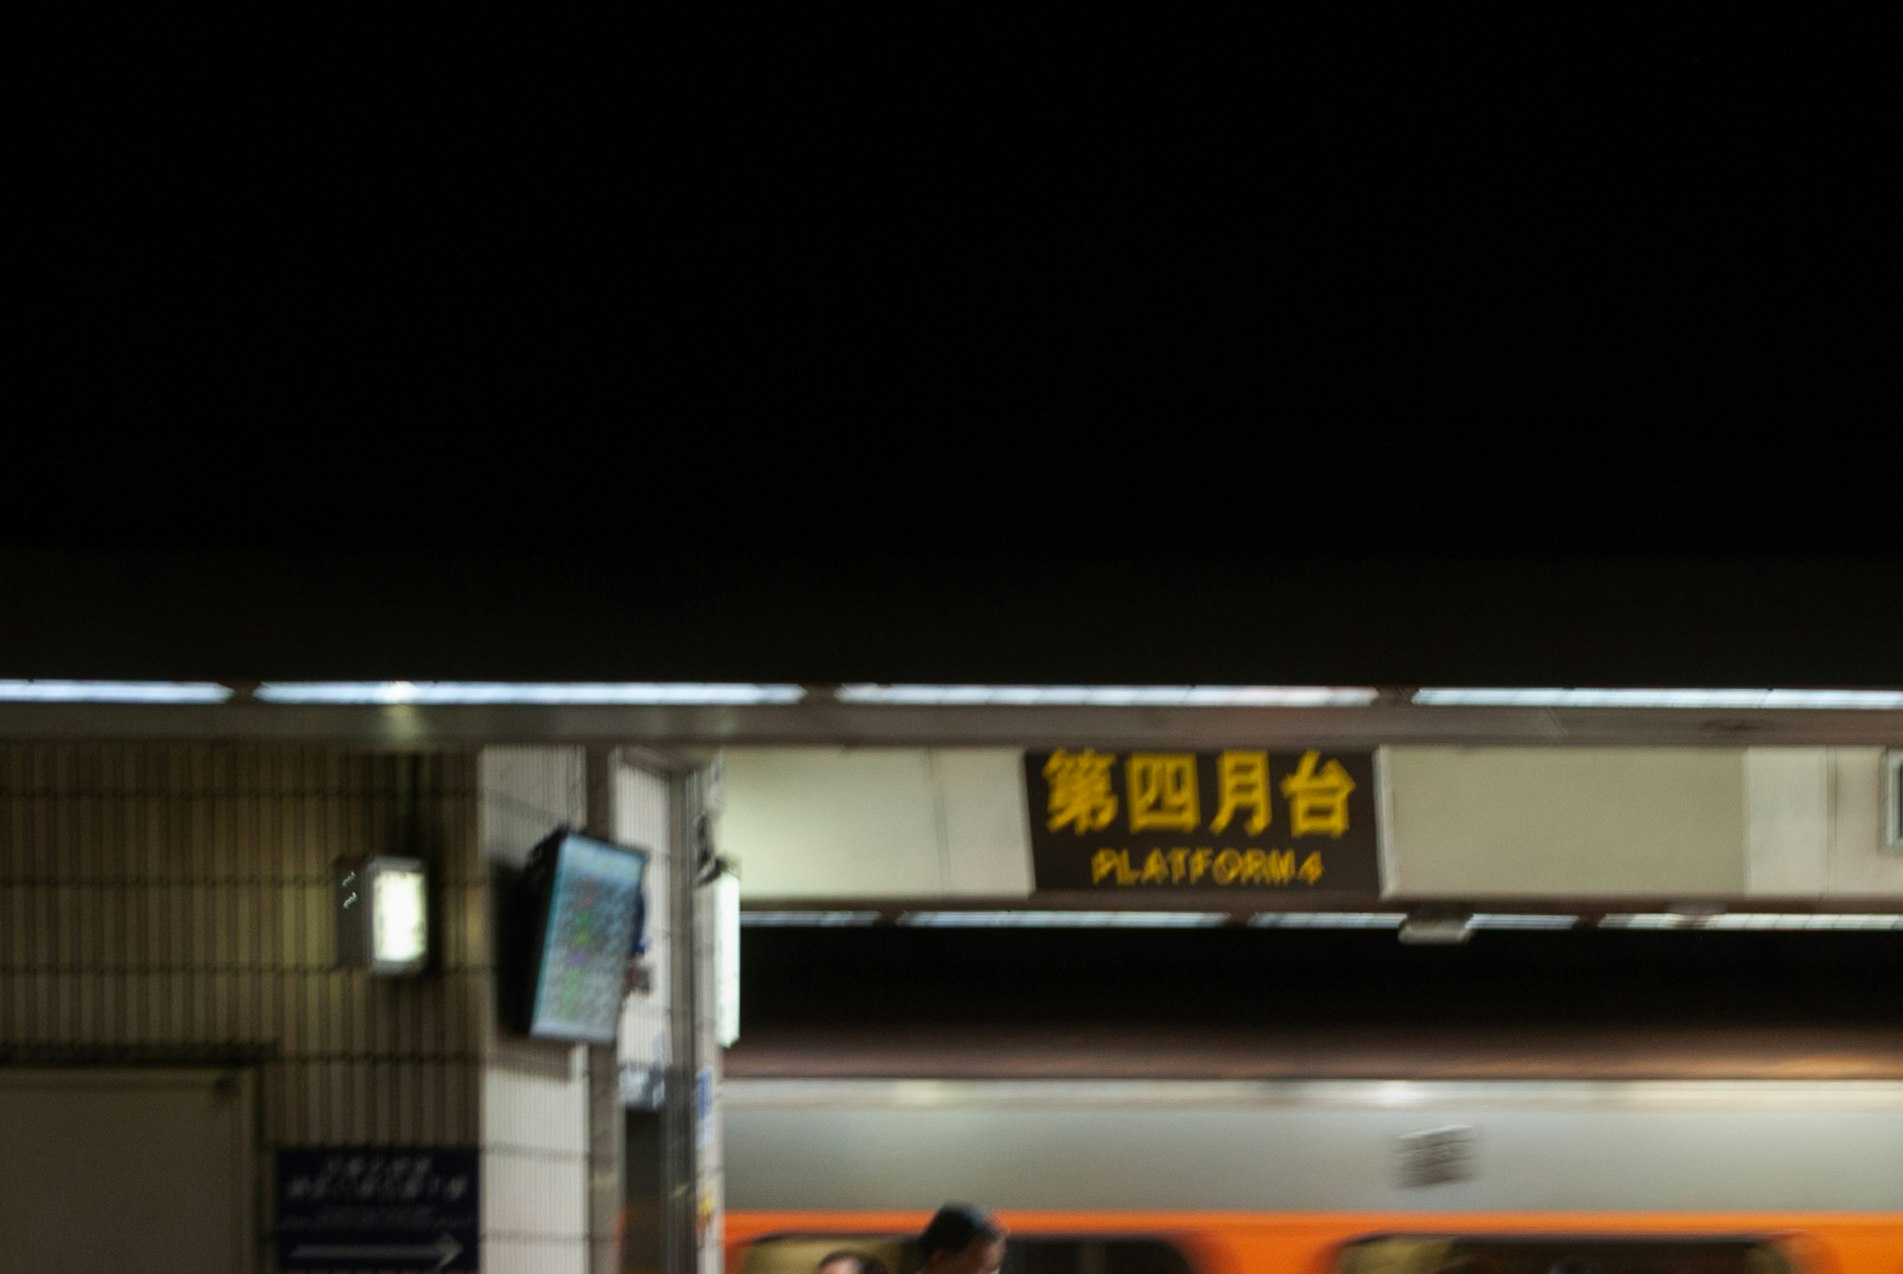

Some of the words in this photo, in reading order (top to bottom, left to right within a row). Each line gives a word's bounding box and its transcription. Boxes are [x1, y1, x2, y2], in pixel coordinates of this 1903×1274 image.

[1043, 748, 1356, 838] 第四月台
[1090, 848, 1296, 885] PLATFORM
[1300, 848, 1325, 885] 4
